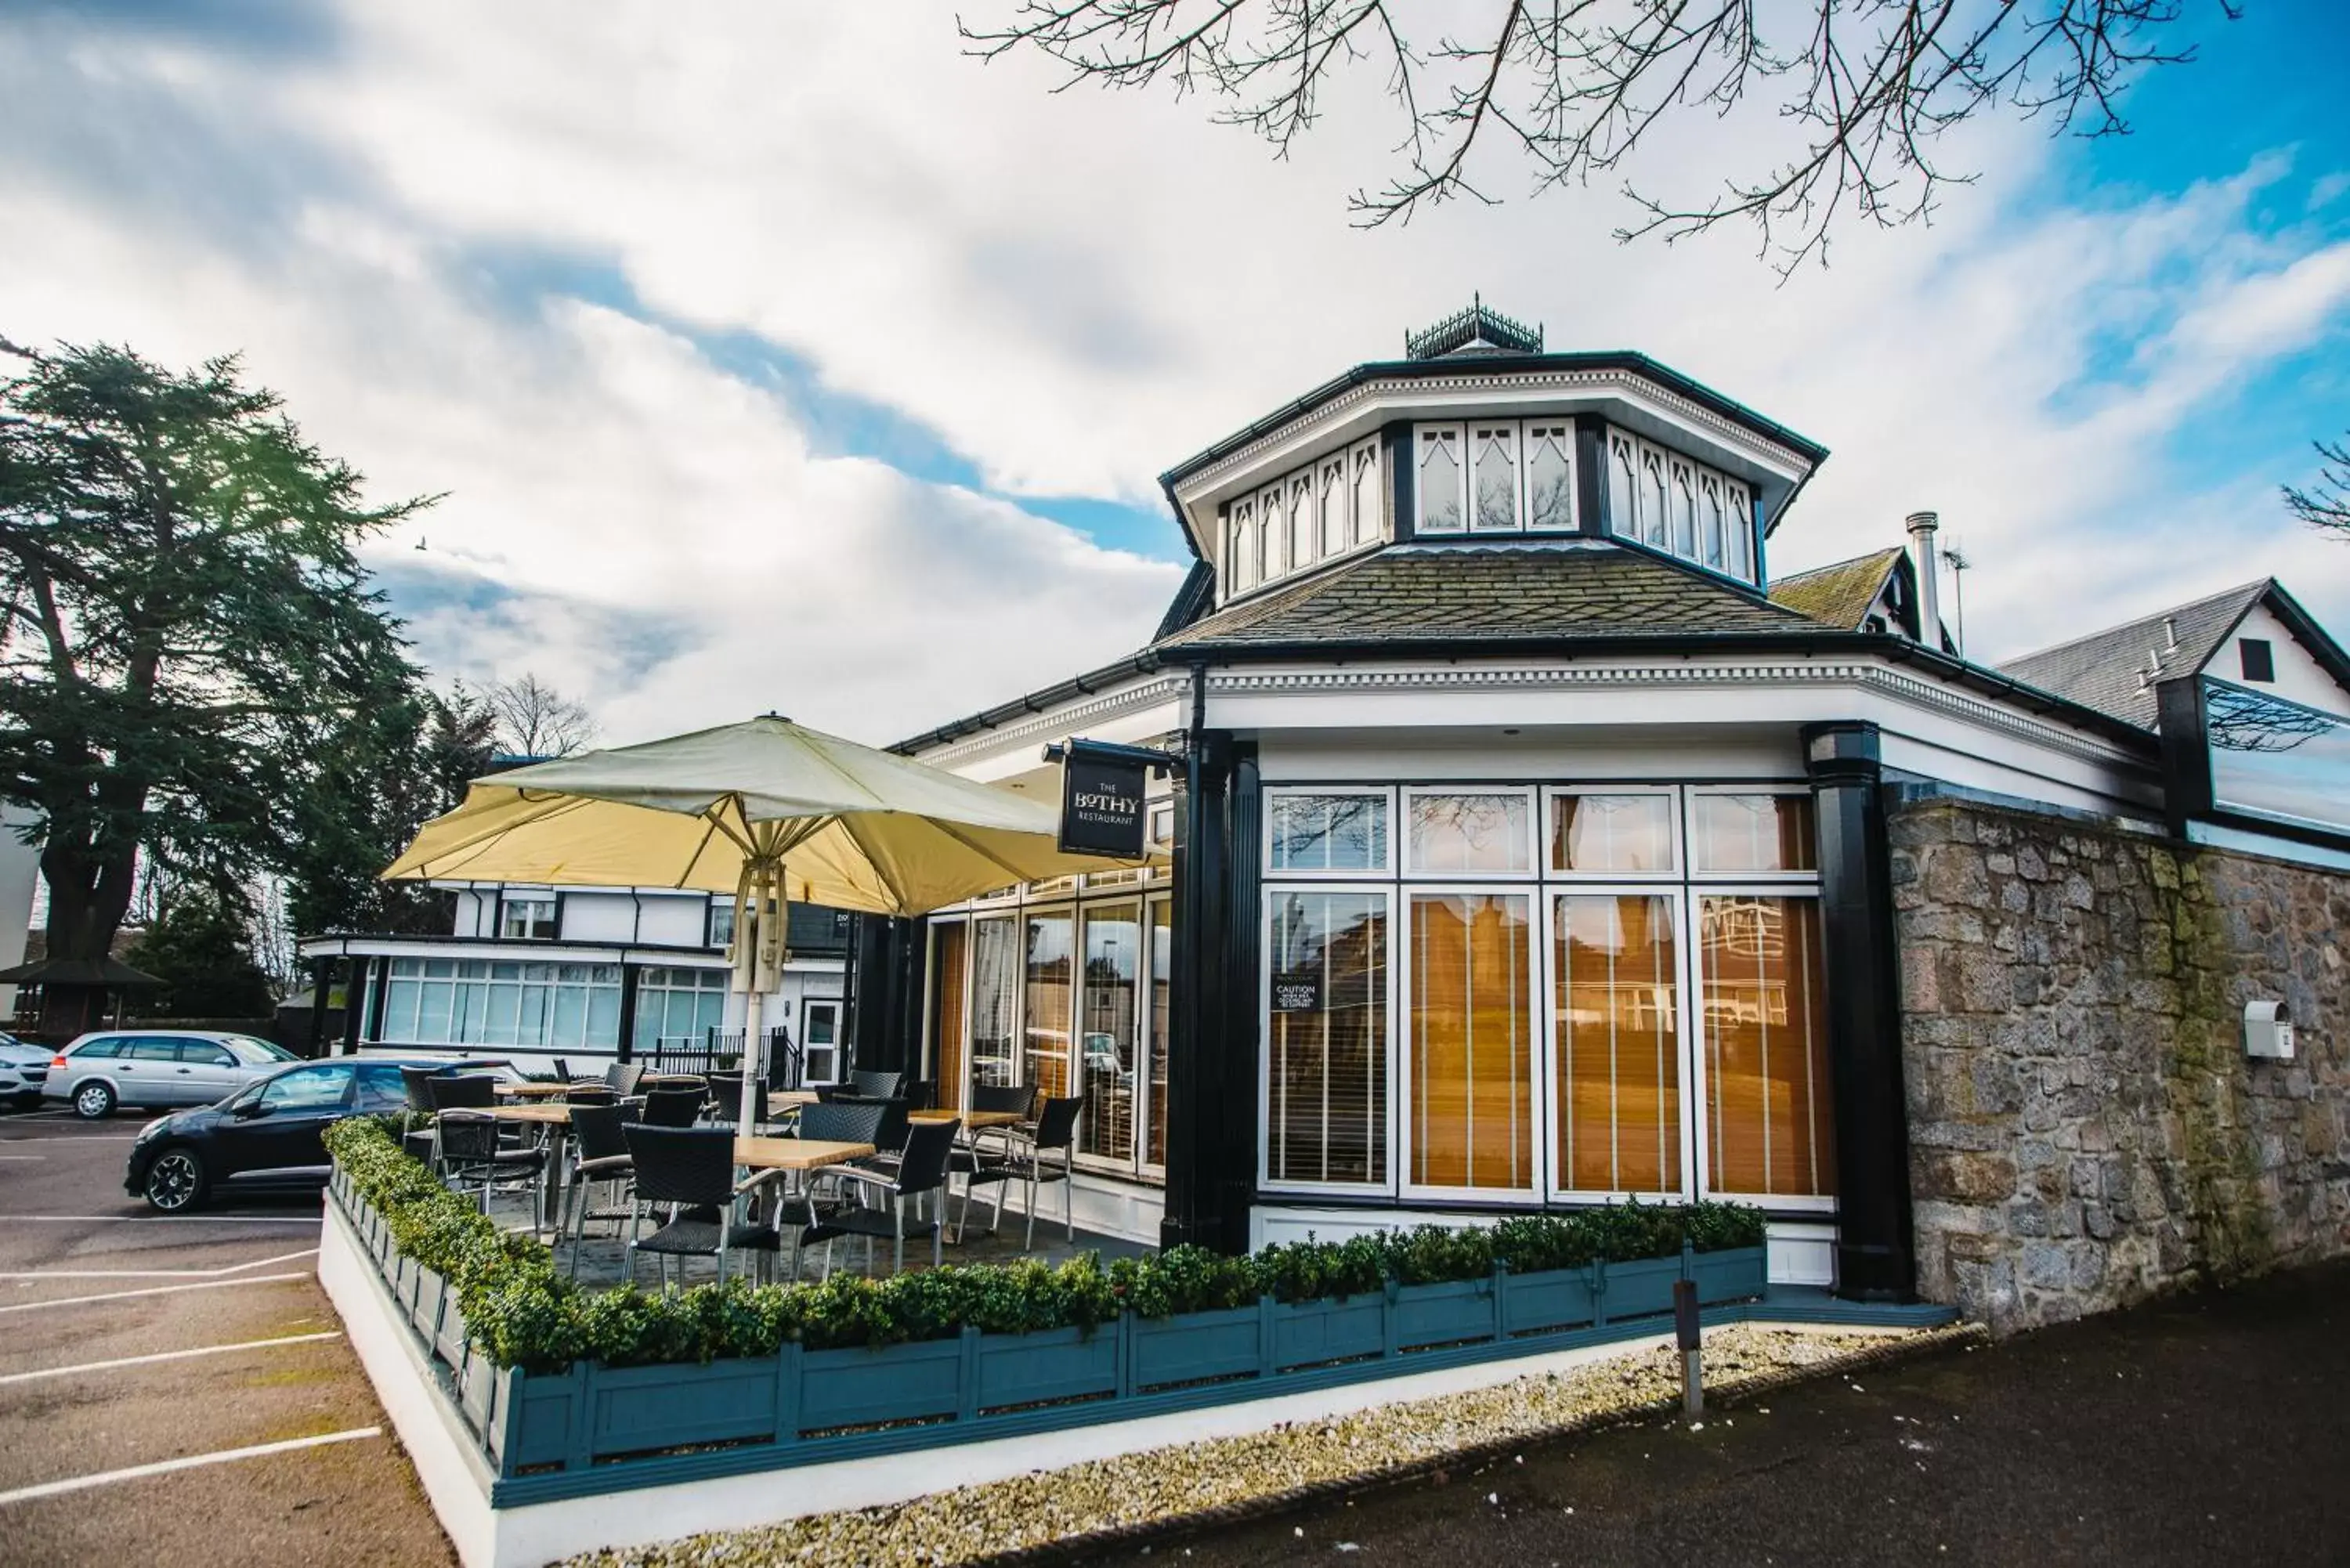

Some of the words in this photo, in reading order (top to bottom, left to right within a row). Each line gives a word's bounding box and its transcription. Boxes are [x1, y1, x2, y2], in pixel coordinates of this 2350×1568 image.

[1100, 782, 1116, 793] THE
[1079, 811, 1134, 826] RESTAURANT
[1276, 985, 1316, 994] CAUTION
